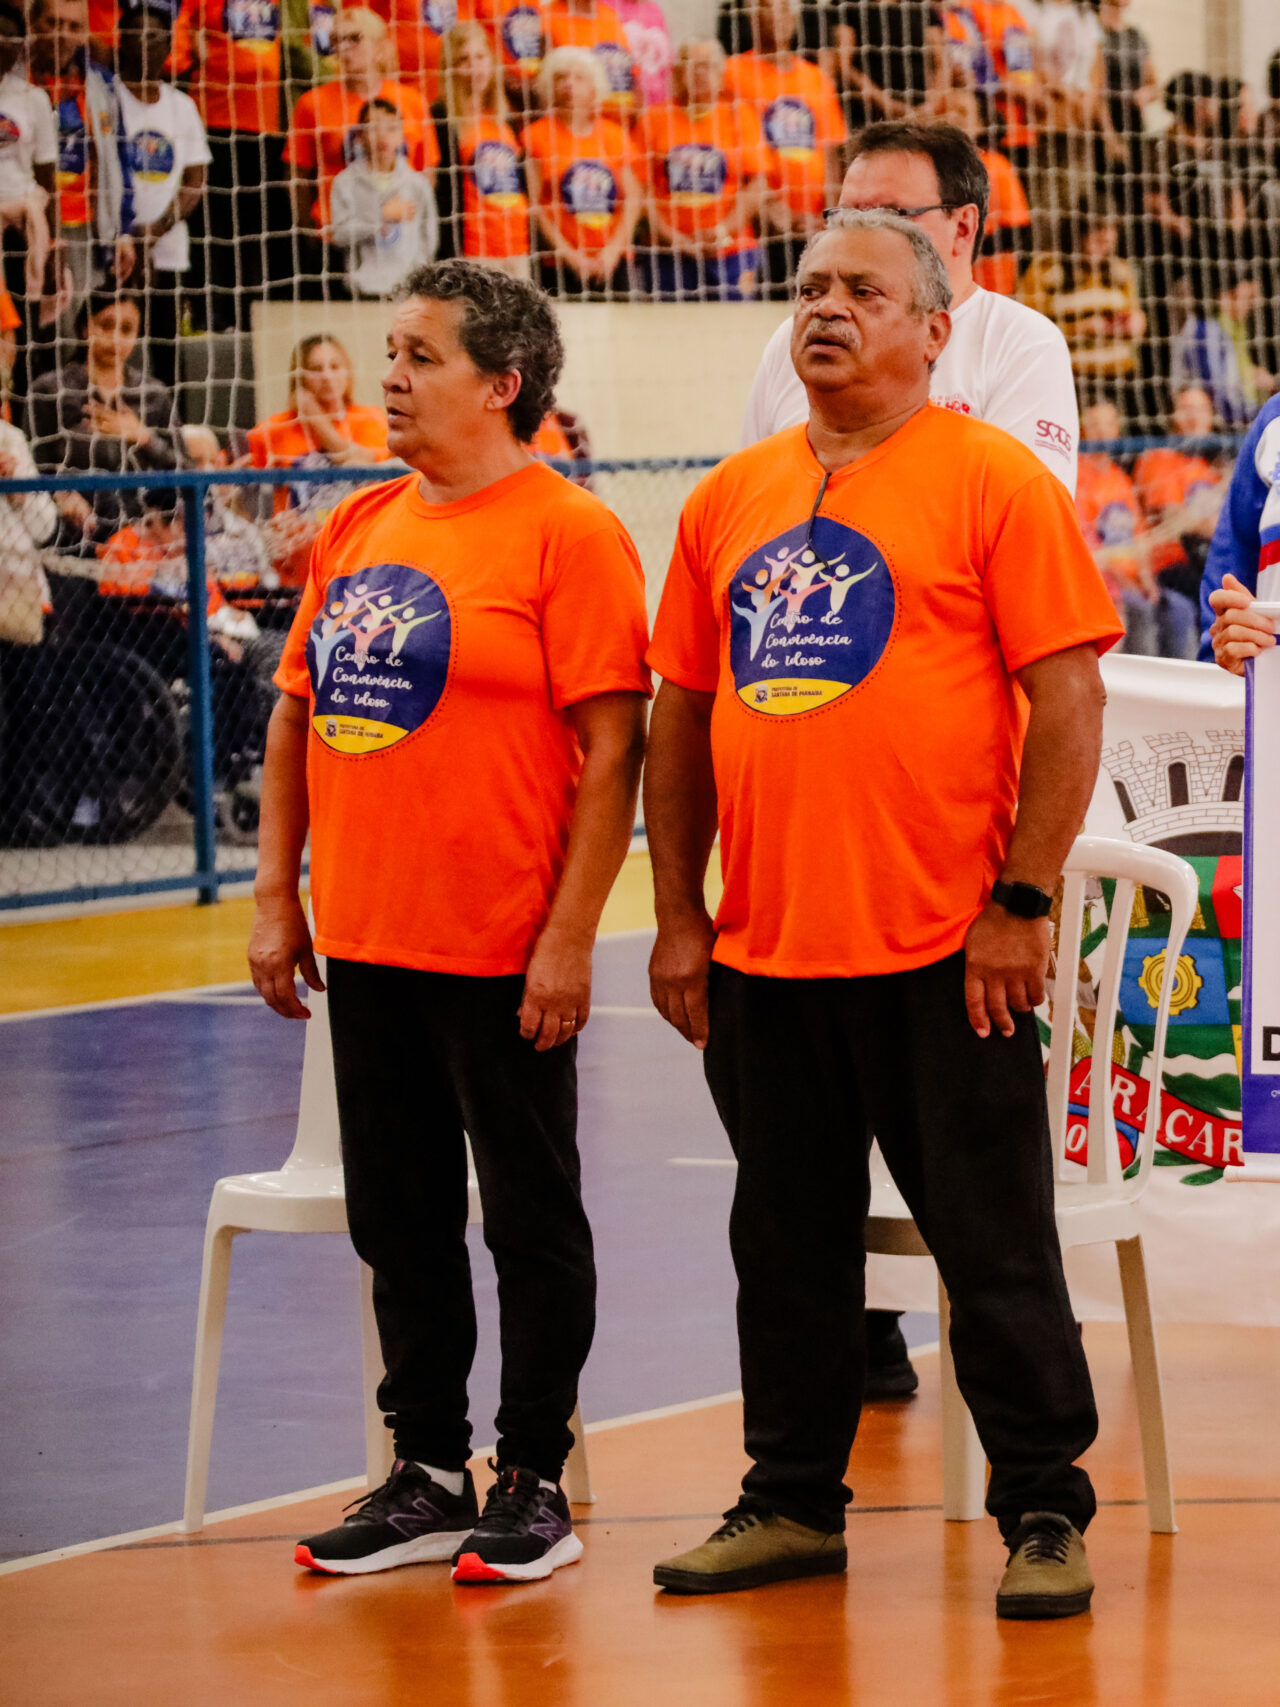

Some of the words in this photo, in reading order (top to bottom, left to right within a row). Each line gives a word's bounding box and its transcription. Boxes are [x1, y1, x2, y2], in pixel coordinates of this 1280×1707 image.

[820, 610, 843, 625] de
[765, 633, 852, 649] Convivência
[335, 645, 379, 666] Centro
[385, 651, 404, 667] de
[761, 653, 779, 669] do
[332, 666, 413, 690] Convivência
[330, 688, 348, 703] do
